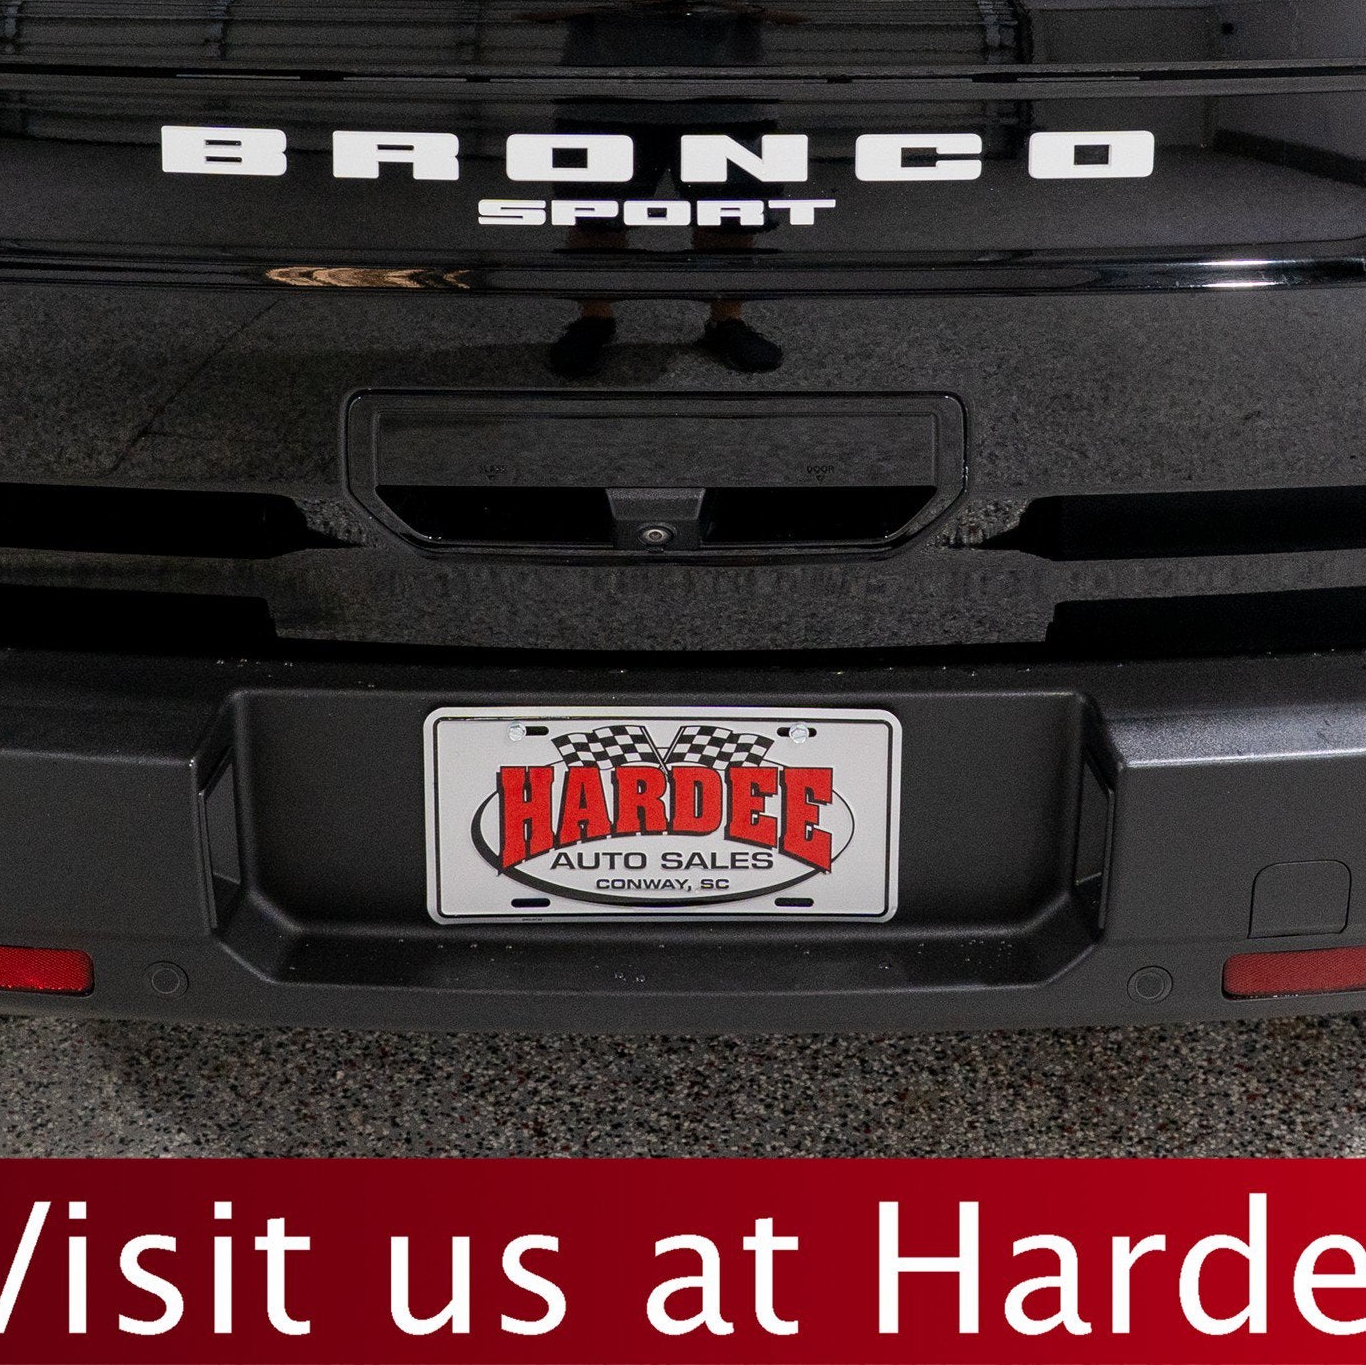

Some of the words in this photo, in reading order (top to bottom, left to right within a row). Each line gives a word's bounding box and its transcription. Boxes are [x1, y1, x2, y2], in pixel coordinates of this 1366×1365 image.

[160, 125, 1156, 183] BRONCO
[477, 198, 836, 227] SPORT
[806, 464, 835, 474] DOOR
[496, 765, 834, 876] HARDEE
[550, 851, 648, 870] AUTO
[660, 850, 774, 870] SALES
[595, 878, 693, 892] CONWAY,
[700, 878, 730, 890] SC
